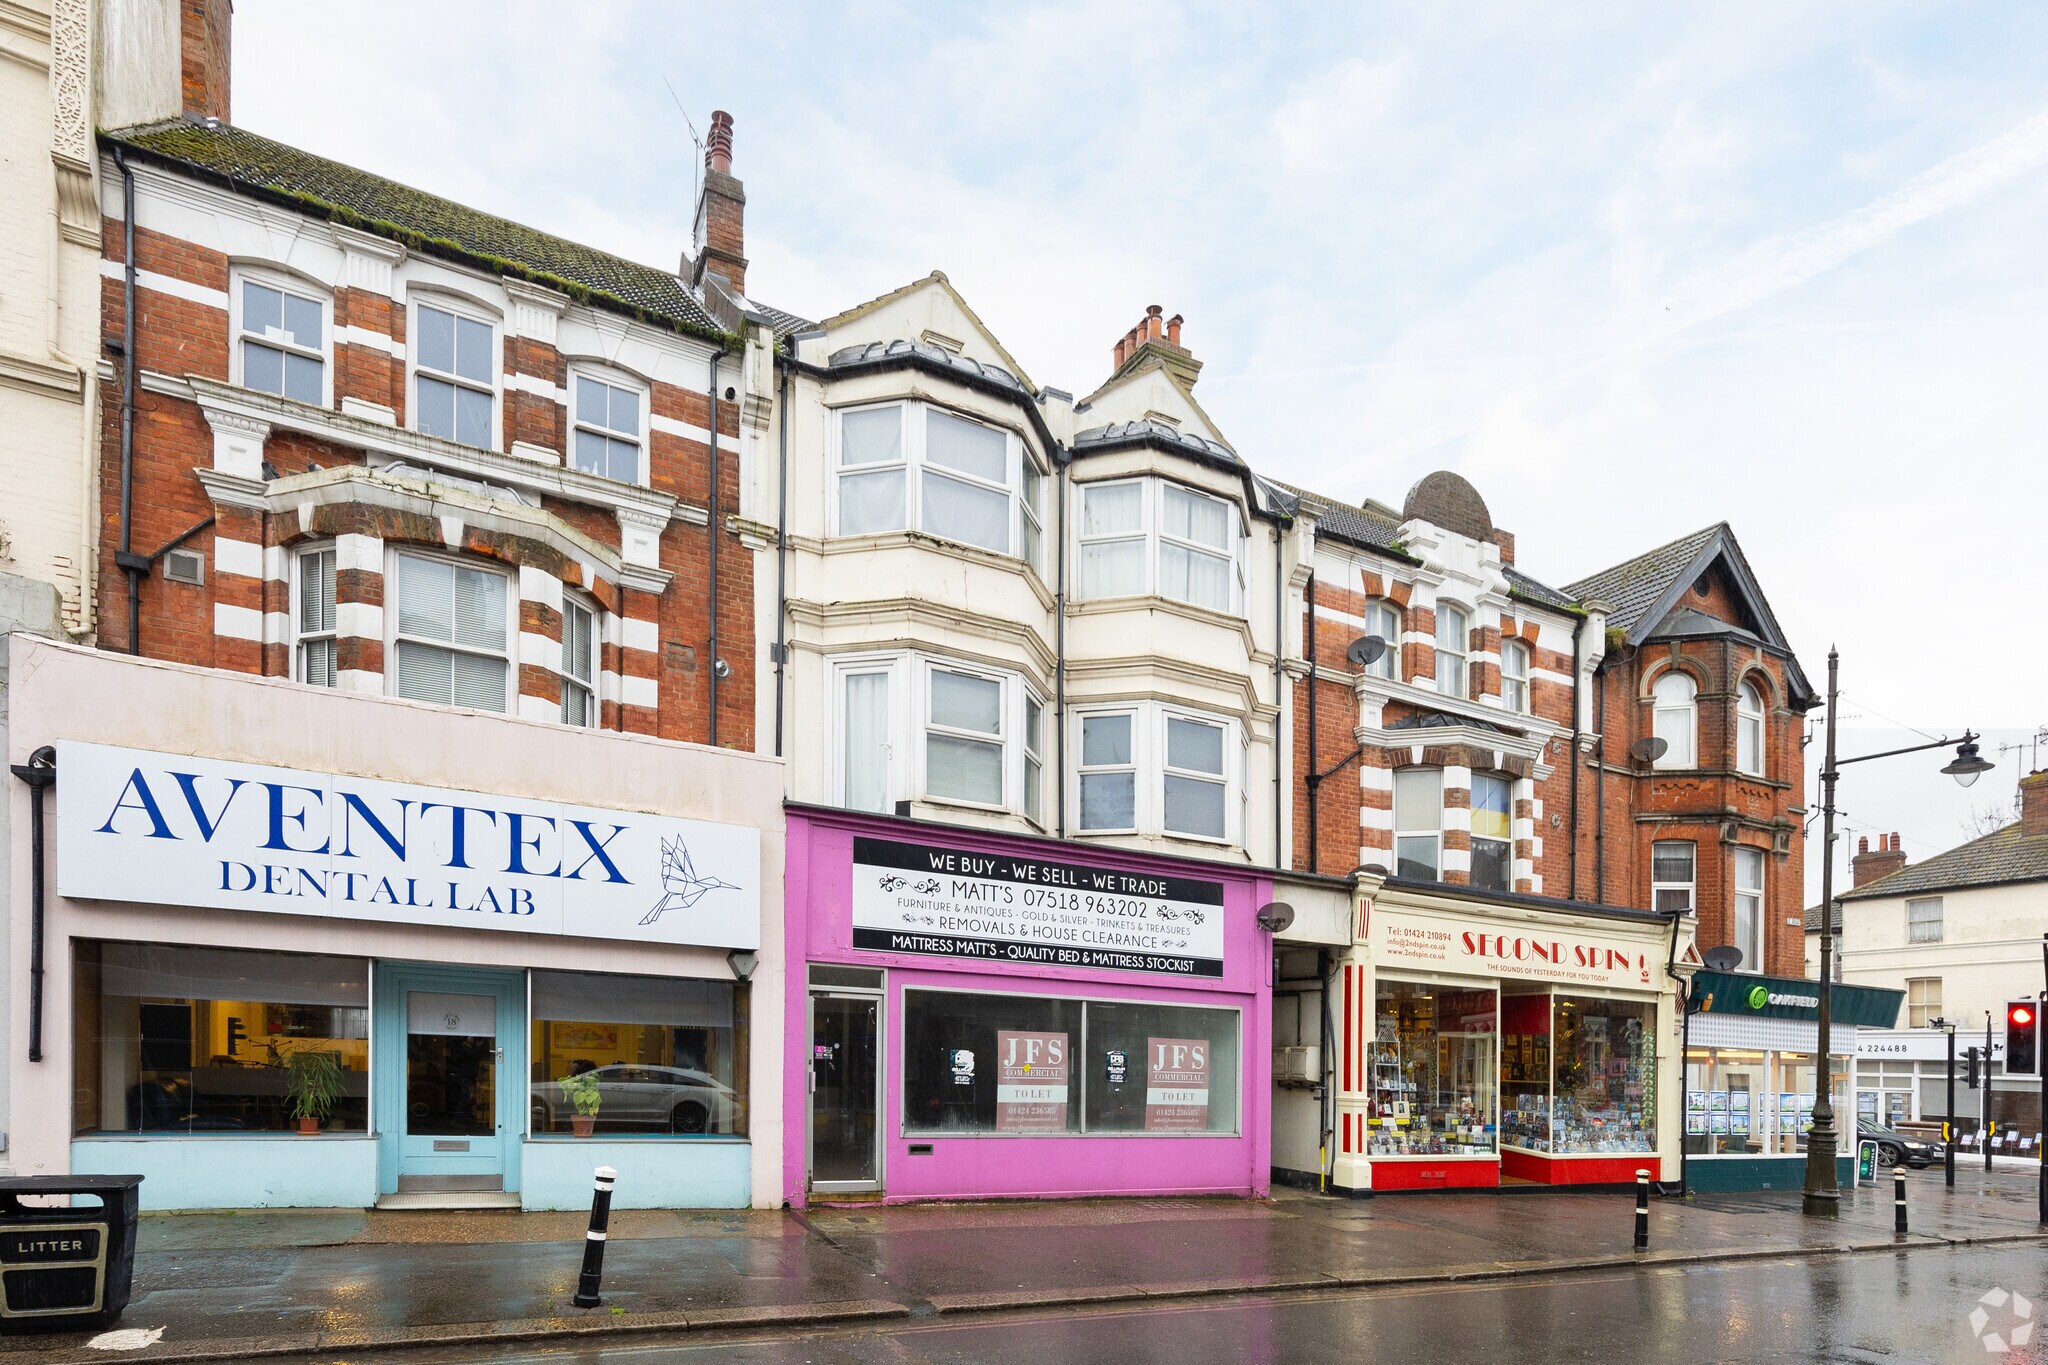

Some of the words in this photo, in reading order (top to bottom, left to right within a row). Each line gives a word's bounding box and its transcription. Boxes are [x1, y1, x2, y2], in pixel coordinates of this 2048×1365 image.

[93, 767, 636, 886] AVENTEX
[929, 853, 955, 871] WE
[961, 857, 996, 875] BUY
[1012, 863, 1037, 881] WE
[1042, 867, 1078, 886] SELL
[1093, 873, 1115, 890] WE
[1120, 877, 1167, 896] TRADE
[218, 860, 434, 909] DENTAL
[445, 881, 536, 916] LAB
[952, 880, 1014, 904] MATT'S
[1024, 889, 1080, 911] 07518
[1086, 895, 1148, 919] 963202
[897, 897, 951, 912] FURNITURE
[955, 904, 961, 913] &
[964, 905, 1013, 918] ANTIQUES
[1022, 910, 1049, 922] GOLD
[1051, 914, 1057, 922] &
[1059, 914, 1088, 926] SILVER
[1096, 918, 1136, 932] TRINKETS
[1138, 922, 1143, 931] &
[1146, 923, 1191, 936] TREASURES
[939, 916, 1015, 936] REMOVALS
[1020, 925, 1028, 936] &
[1033, 925, 1078, 941] HOUSE
[1082, 930, 1158, 949] CLEARANCE
[1387, 926, 1402, 936] Tel:
[1404, 928, 1425, 939] 01424
[1427, 930, 1452, 941] 210894
[892, 935, 954, 952] MATTRESS
[956, 940, 997, 956] MATT'S
[1007, 945, 1057, 962] QUALITY
[1058, 949, 1080, 963] BED
[1082, 951, 1090, 964] &
[1093, 953, 1144, 968] MATTRESS
[1146, 957, 1195, 972] STOCKIST
[1387, 938, 1447, 951] info@2ndspin.co.uk
[1387, 949, 1446, 960] www.2ndspin.co.uk
[1460, 931, 1568, 965] SECOND
[1574, 944, 1630, 972] SPIN
[1487, 963, 1499, 971] THE
[1499, 964, 1524, 974] SOUNDS
[1533, 968, 1566, 978] YESTERDAY
[1566, 971, 1577, 979] FOR
[1578, 972, 1590, 981] YOU
[1591, 974, 1610, 983] TODAY
[1003, 1038, 1063, 1067] JFS
[1153, 1044, 1205, 1071] JFS
[1867, 1044, 1908, 1053] 224488
[1005, 1069, 1061, 1077] COMMERCIAL
[1154, 1073, 1203, 1081] COMMERCIAL
[1014, 1089, 1028, 1098] TO
[1031, 1089, 1053, 1099] LET
[1161, 1092, 1174, 1101] TO
[1176, 1092, 1196, 1101] LET
[1008, 1106, 1030, 1115] 01424
[18, 1240, 83, 1253] LITTER
